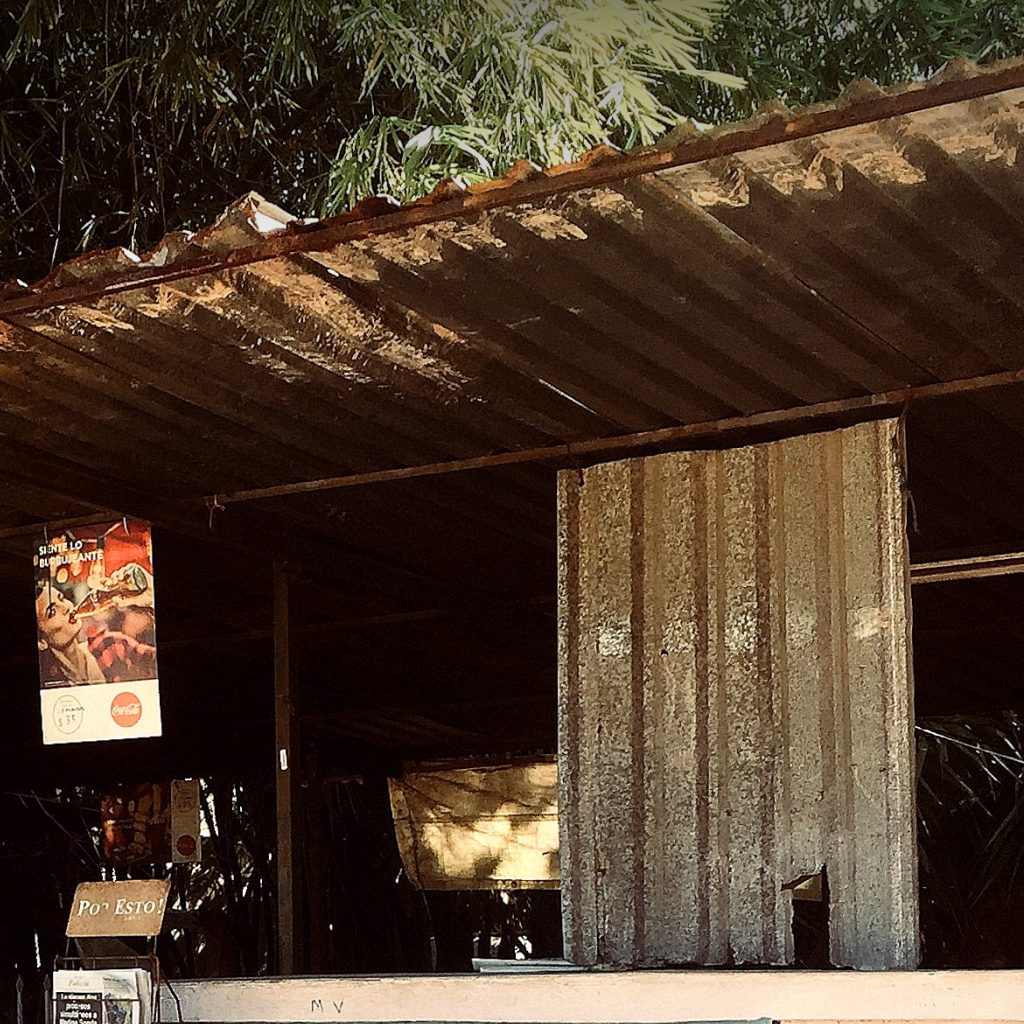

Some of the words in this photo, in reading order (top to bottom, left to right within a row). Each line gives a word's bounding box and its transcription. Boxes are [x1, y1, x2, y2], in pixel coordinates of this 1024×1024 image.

[39, 542, 68, 556] SIENTE
[70, 540, 83, 550] LO
[39, 550, 104, 568] BURBUJEANTE
[311, 999, 324, 1013] M
[333, 1000, 344, 1014] V
